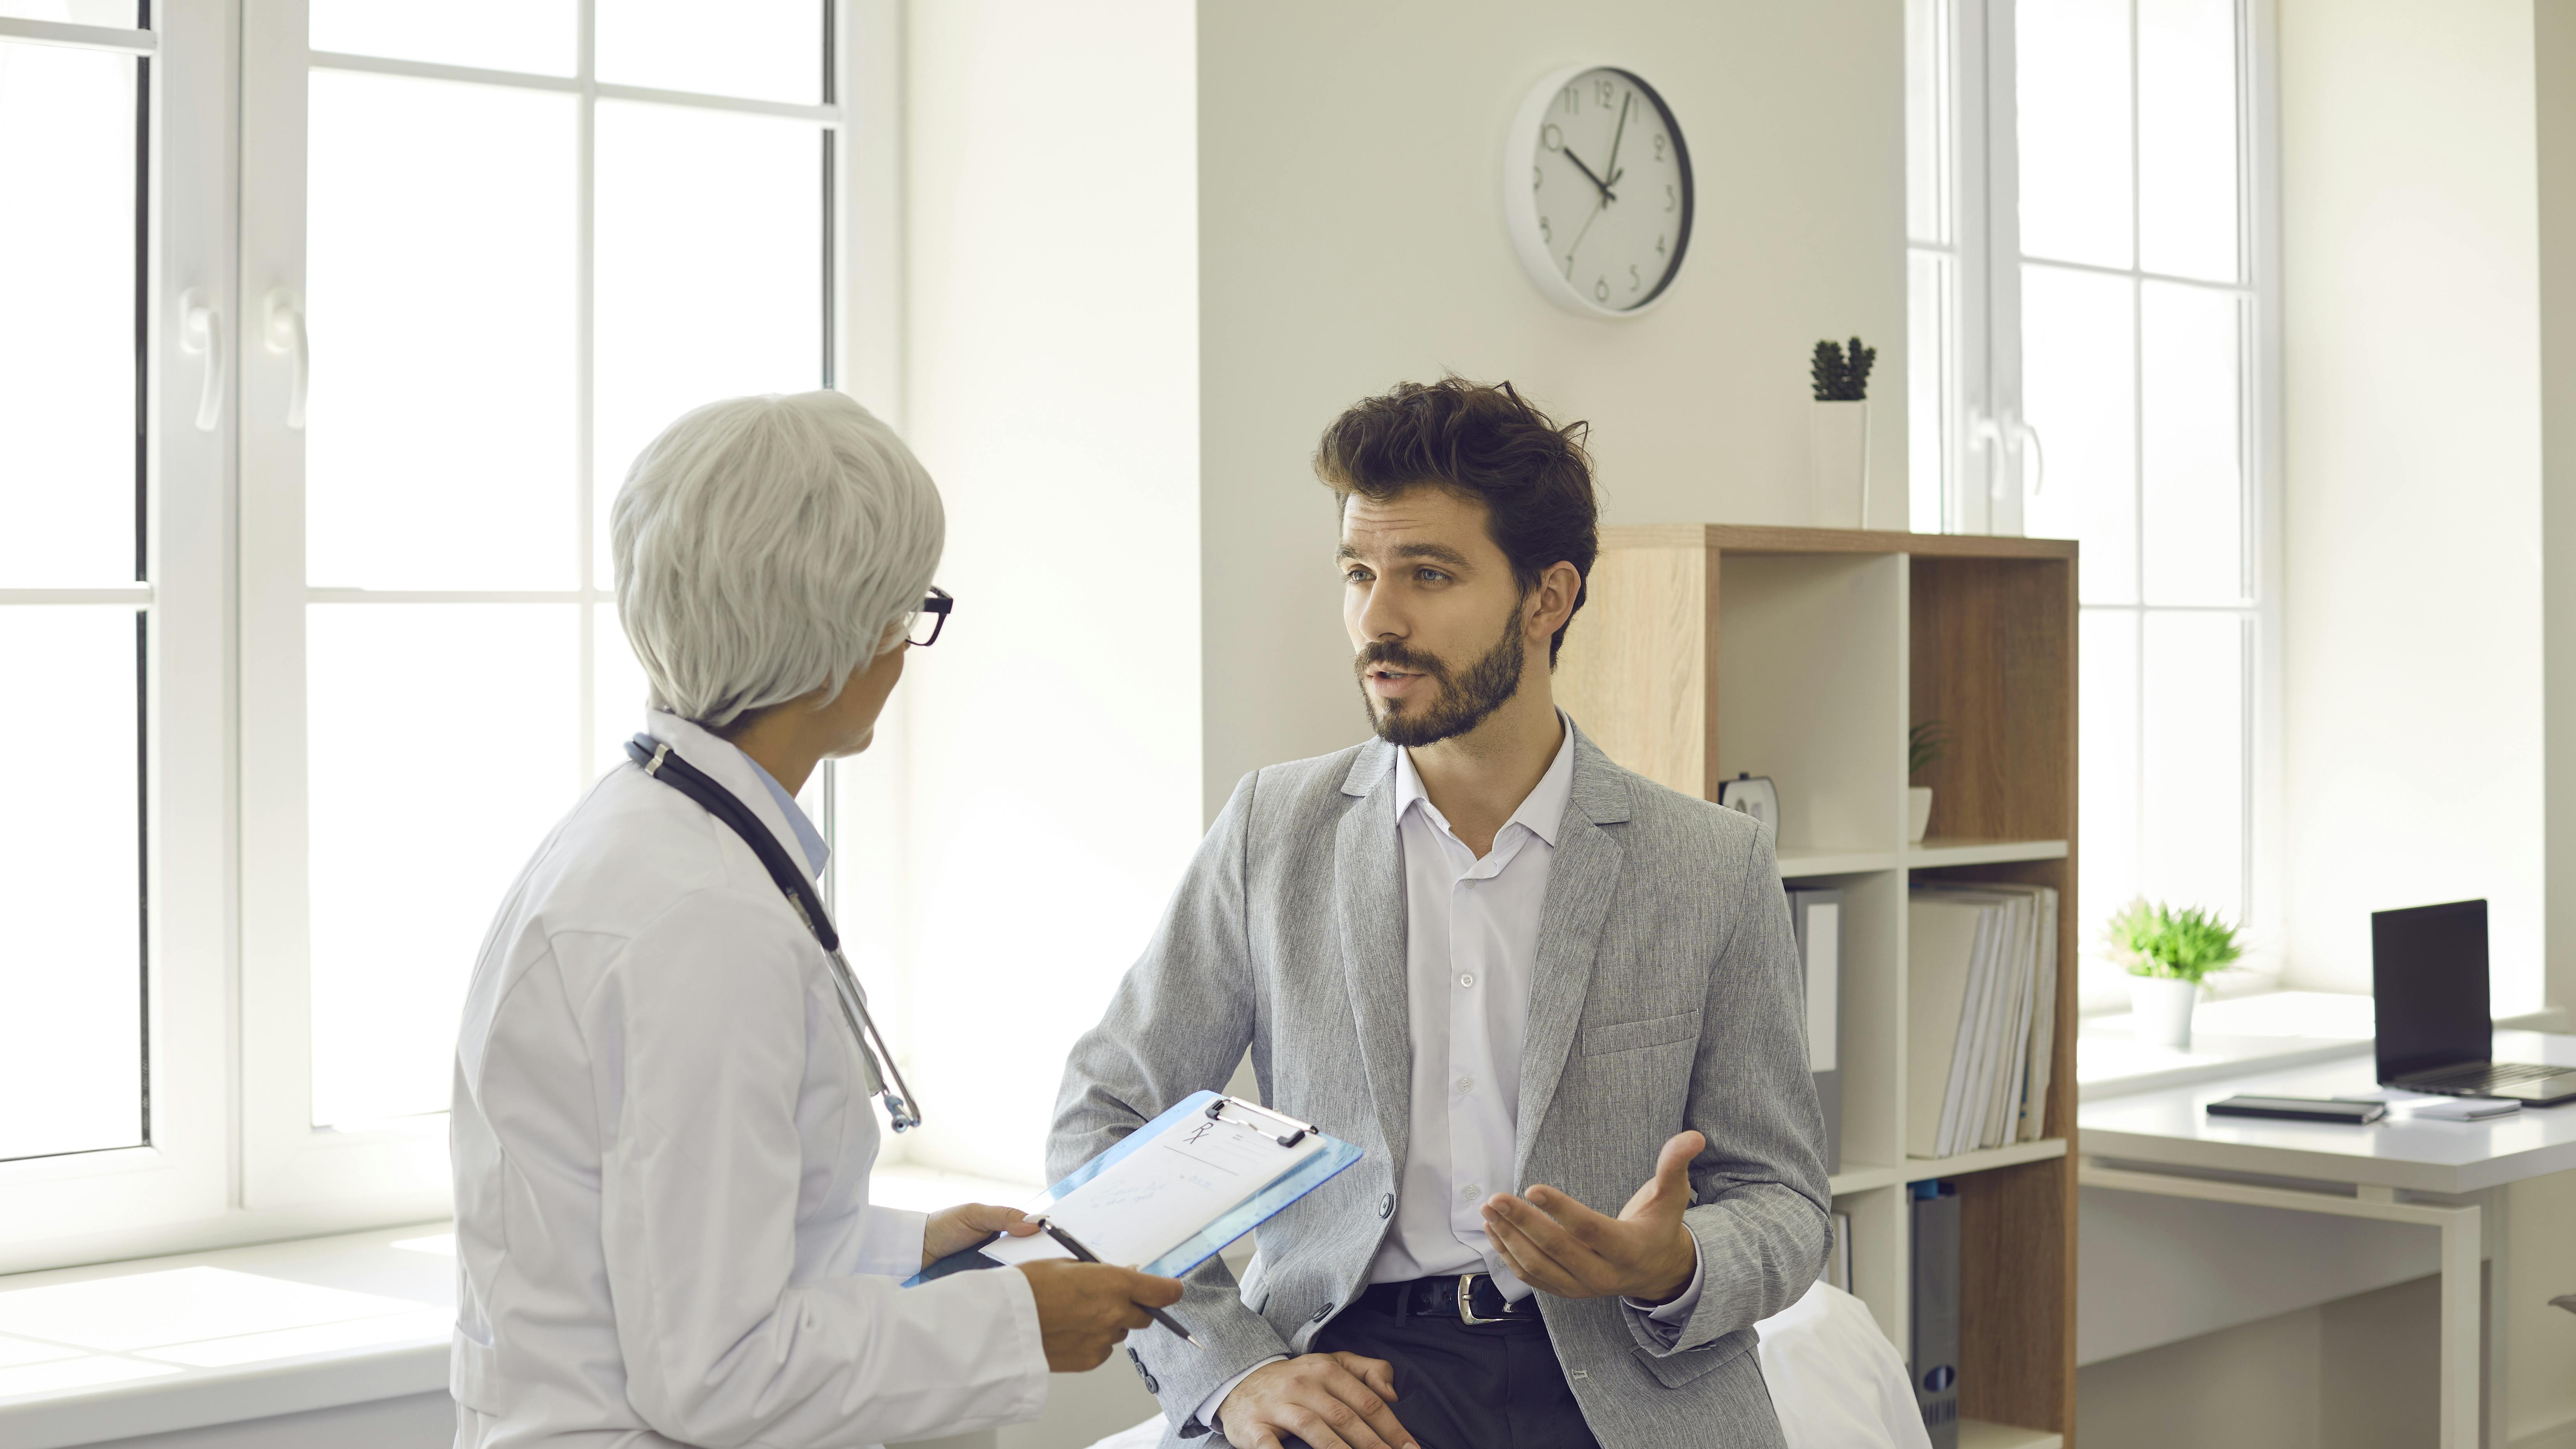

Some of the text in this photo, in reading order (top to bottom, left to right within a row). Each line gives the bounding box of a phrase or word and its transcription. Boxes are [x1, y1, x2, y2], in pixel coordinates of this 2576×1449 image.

[1563, 87, 1579, 115] 11
[1594, 80, 1614, 110] 12
[1633, 97, 1639, 123] 1
[1541, 123, 1564, 152] 10
[1654, 134, 1665, 161] 2
[1665, 185, 1676, 213] 3
[1656, 235, 1665, 257] 4
[1594, 274, 1610, 303] 6
[1629, 265, 1641, 292] 5
